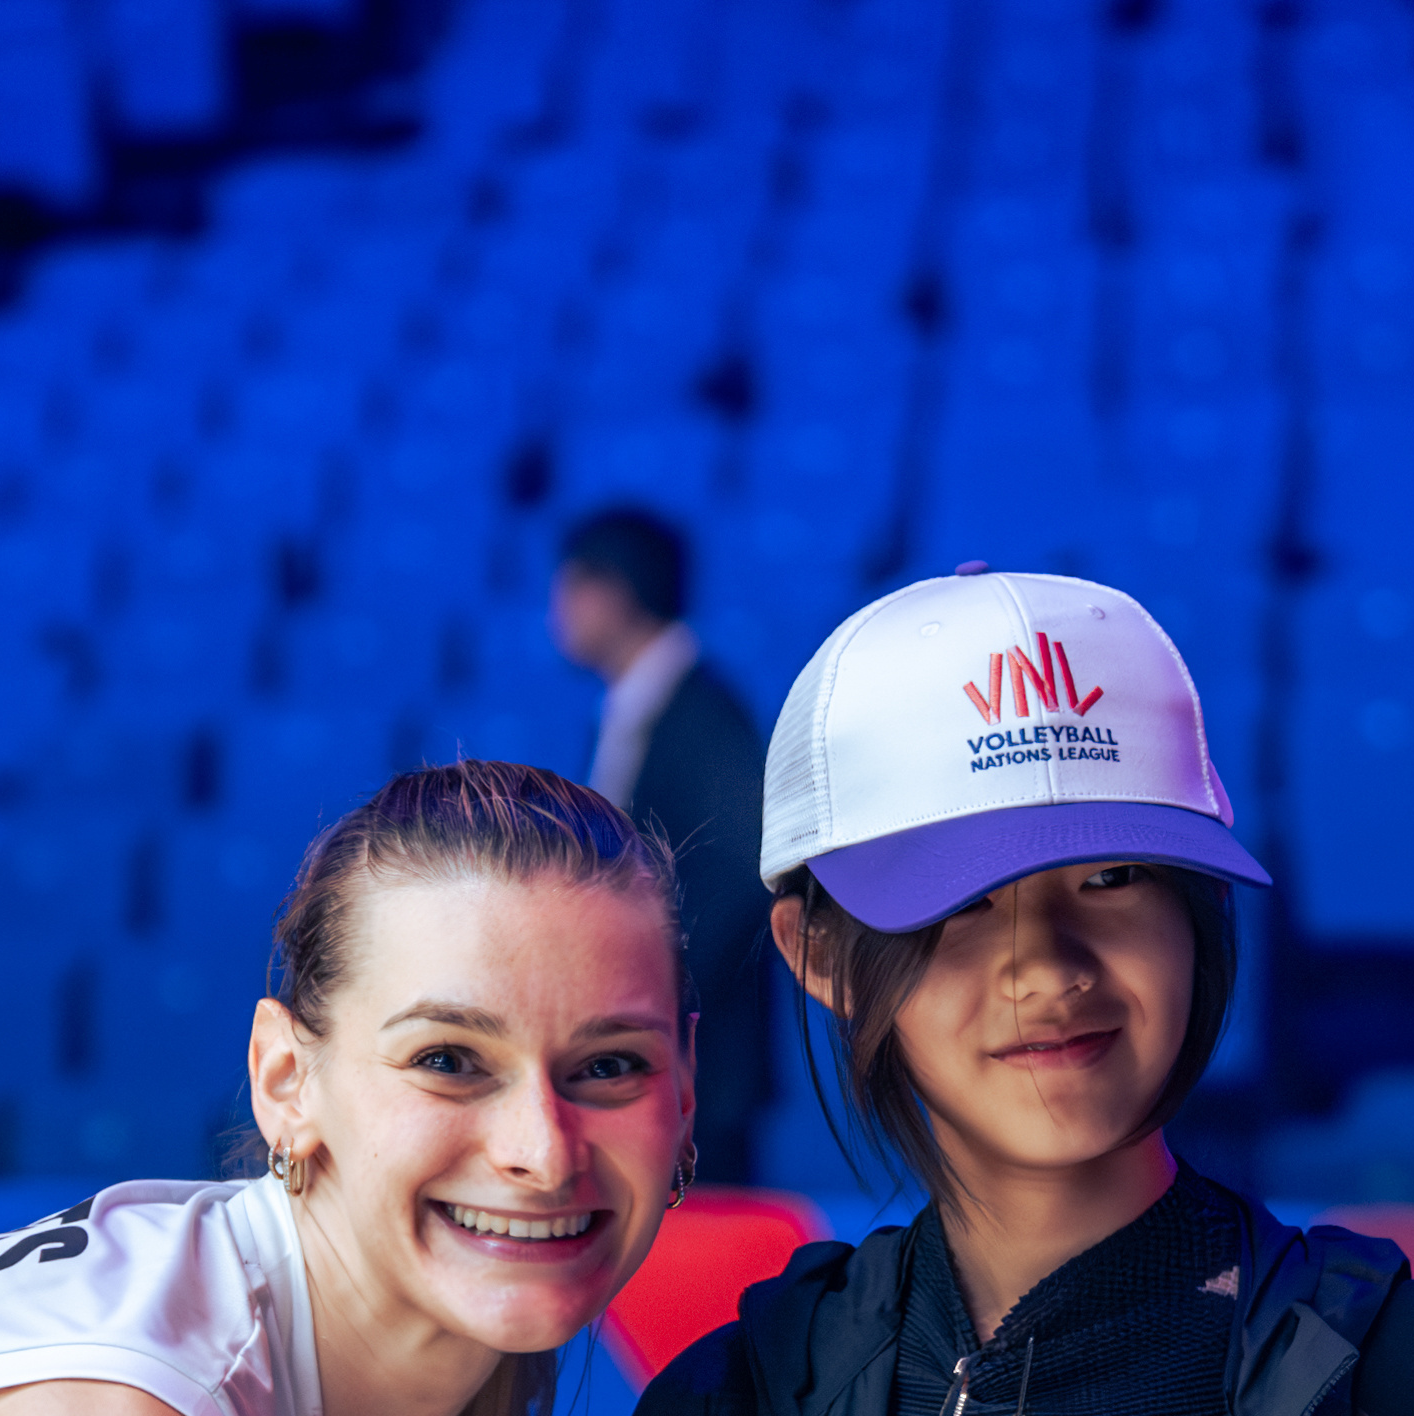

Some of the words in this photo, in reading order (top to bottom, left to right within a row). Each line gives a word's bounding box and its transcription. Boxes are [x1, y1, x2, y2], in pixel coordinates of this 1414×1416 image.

[963, 632, 1104, 725] VNL
[967, 725, 1119, 755] VOLLEYBALL
[971, 748, 1052, 773] NATIONS
[1059, 747, 1121, 763] LEAGUE
